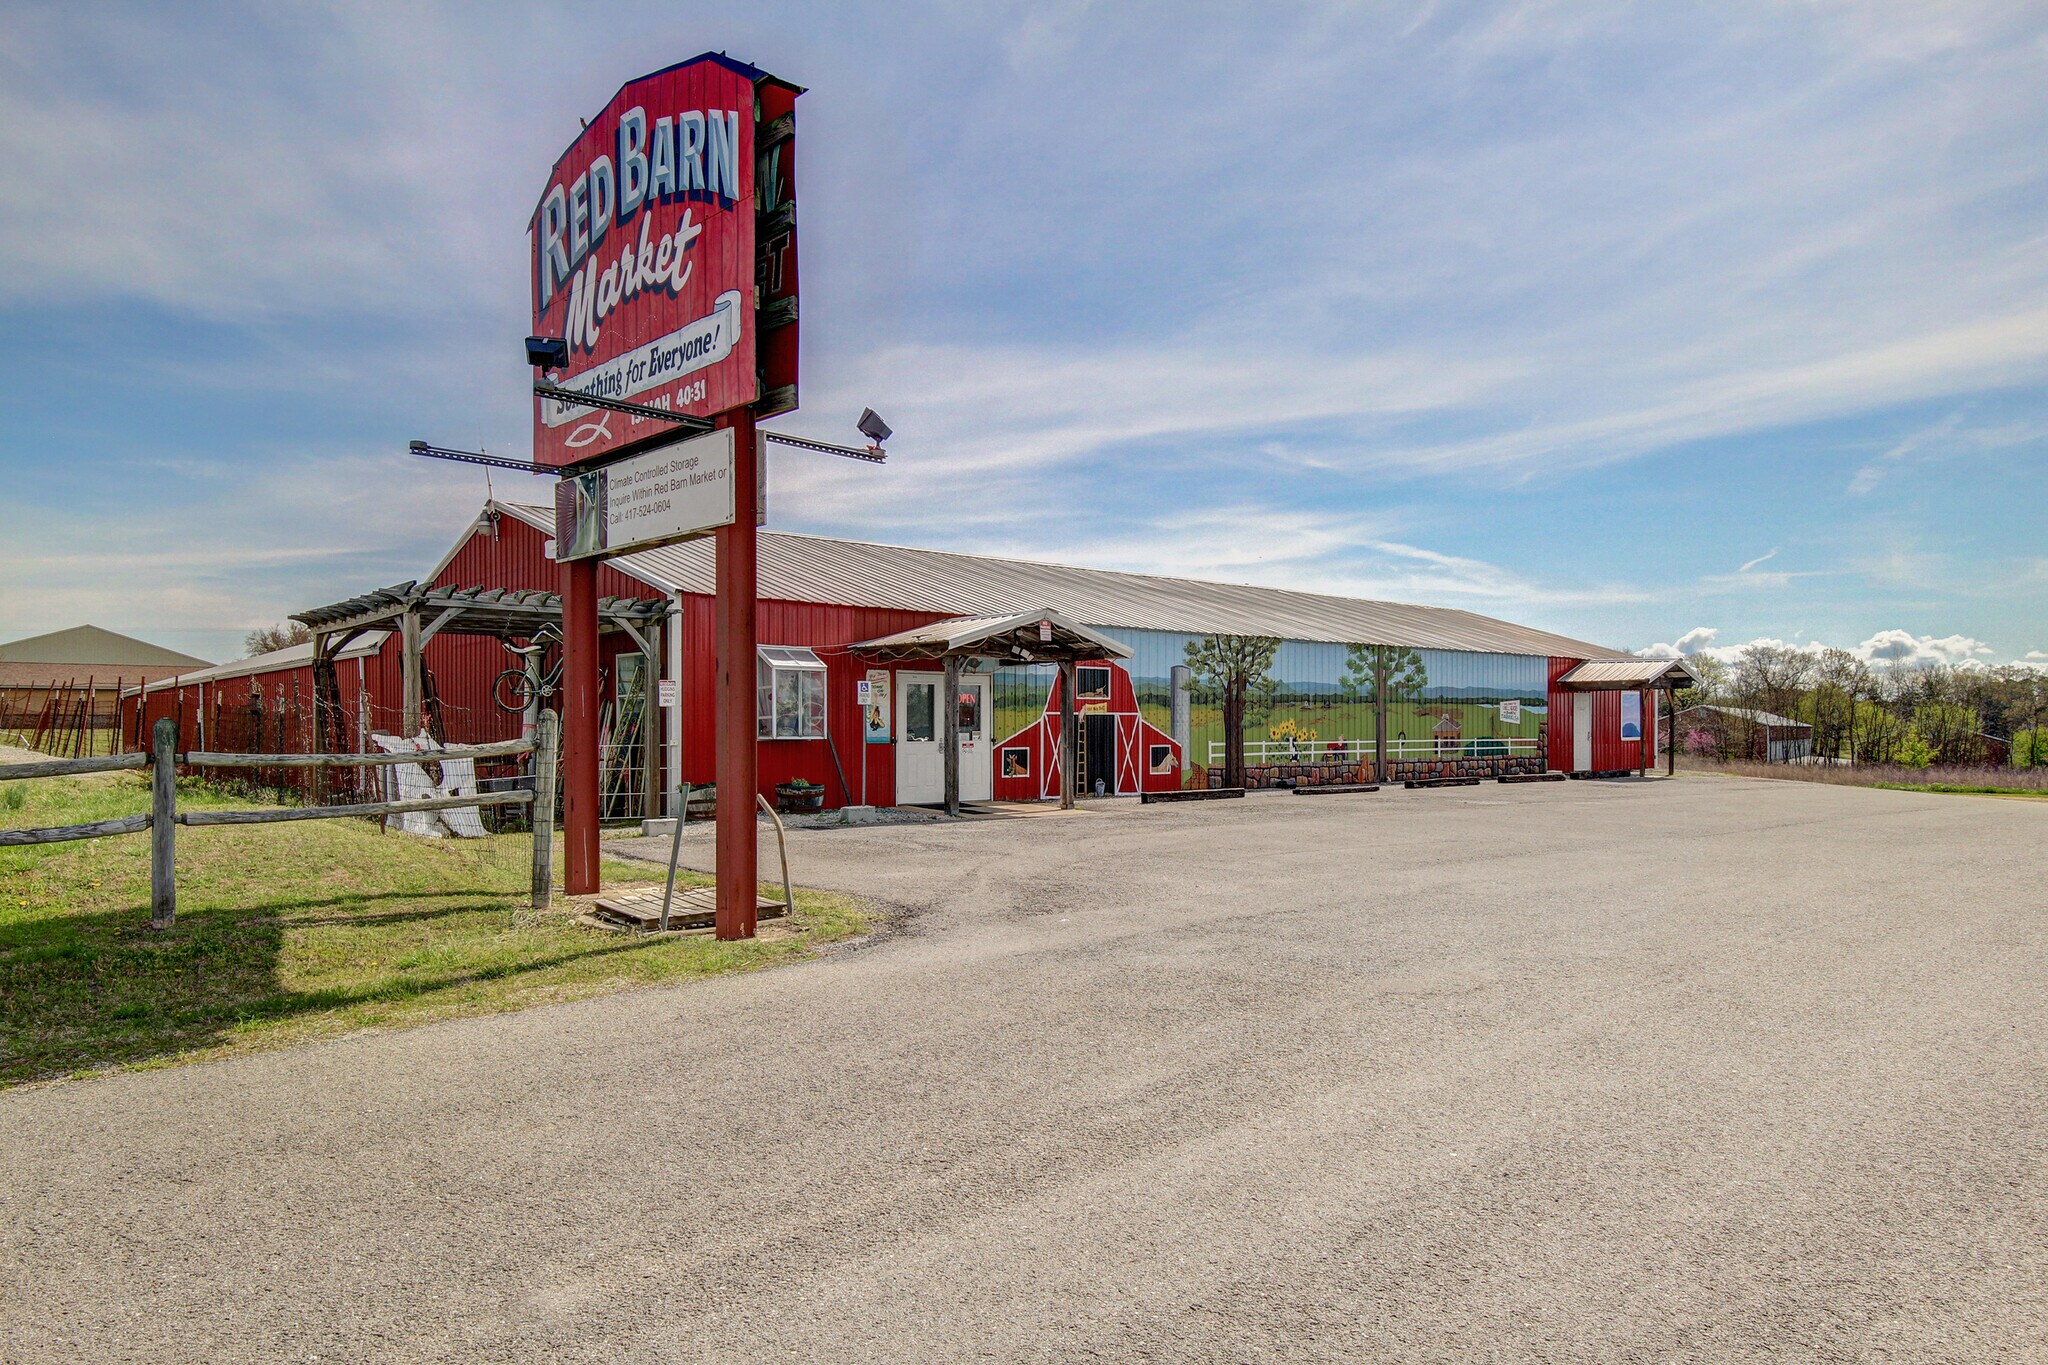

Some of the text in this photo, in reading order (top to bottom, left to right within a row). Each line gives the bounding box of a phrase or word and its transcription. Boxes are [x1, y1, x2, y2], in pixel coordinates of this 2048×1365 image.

[541, 154, 615, 310] RED
[619, 105, 740, 217] BARN
[564, 208, 702, 348] Market
[624, 358, 647, 394] for
[648, 324, 721, 378] Everyone!
[676, 378, 706, 408] 40:31
[609, 456, 699, 491] Climate Controlled Storage
[609, 467, 727, 509] Inquire Within Red Barn Market or
[609, 499, 671, 525] Call: 417-524-0604
